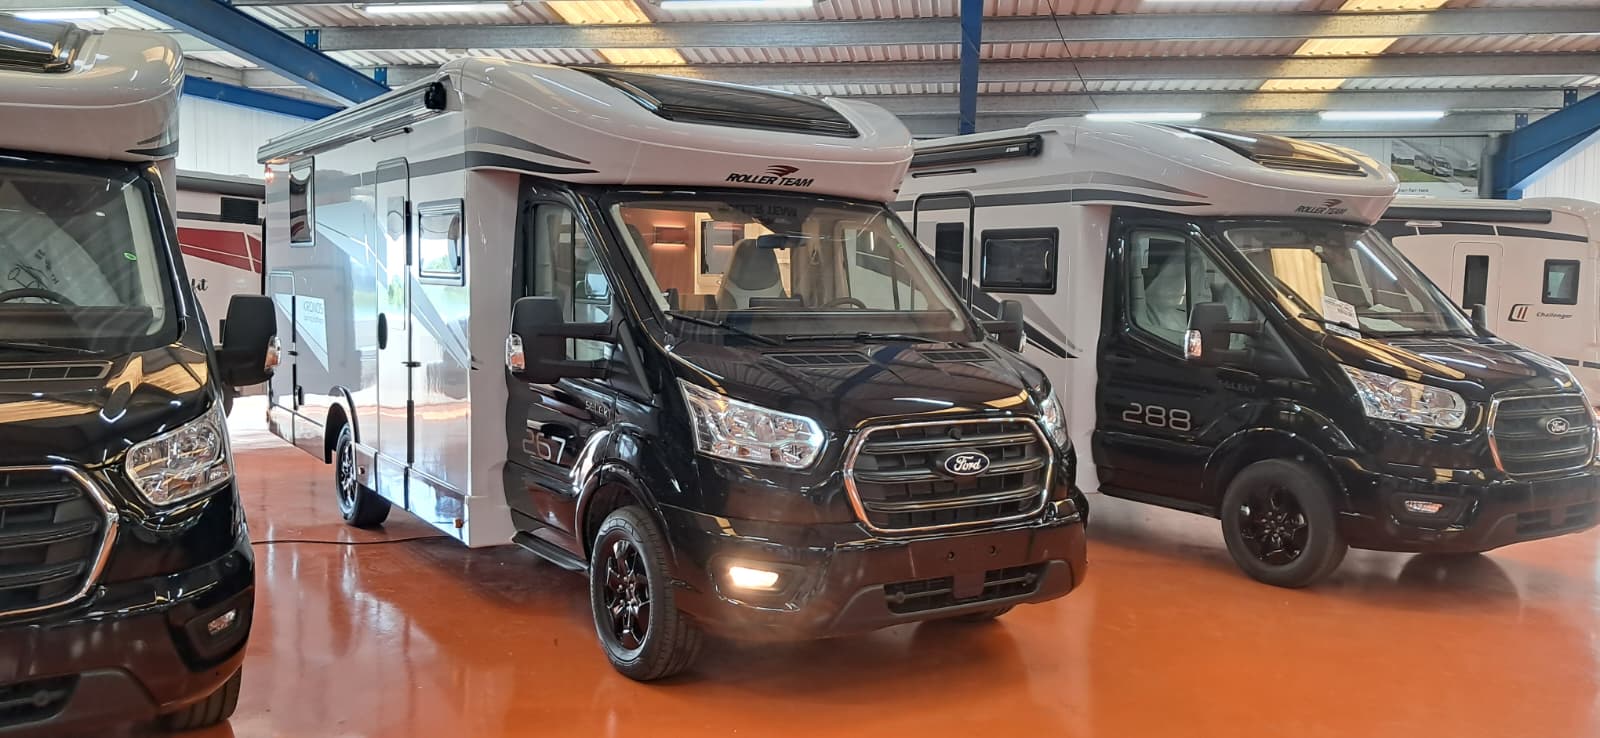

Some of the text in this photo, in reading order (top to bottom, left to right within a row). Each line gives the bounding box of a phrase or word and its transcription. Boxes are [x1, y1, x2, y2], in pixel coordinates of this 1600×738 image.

[725, 173, 815, 187] ROLLER TEAM
[1122, 402, 1191, 432] 288
[522, 429, 566, 464] 267
[953, 455, 982, 472] Ford
